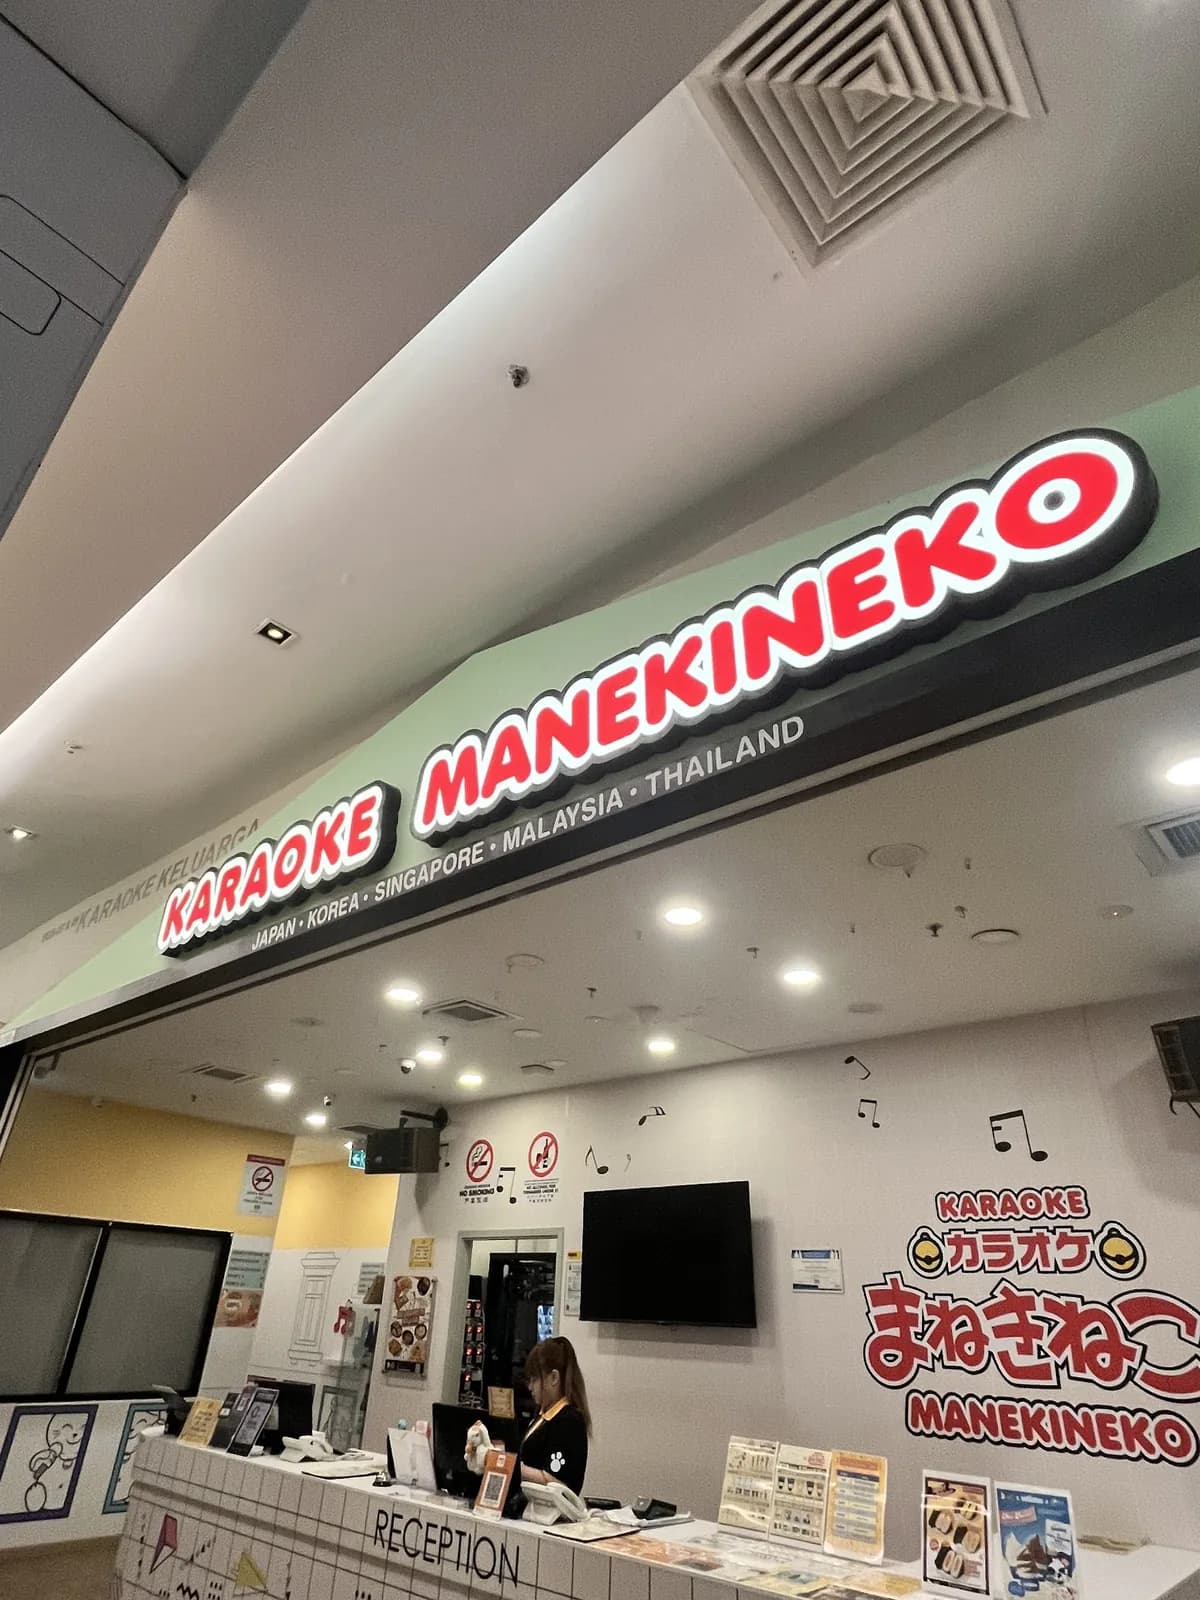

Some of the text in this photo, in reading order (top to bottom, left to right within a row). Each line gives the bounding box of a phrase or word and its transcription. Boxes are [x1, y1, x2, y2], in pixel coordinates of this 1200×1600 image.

[162, 450, 1120, 942] KARAOKE MANEKINEKO
[76, 818, 258, 932] KARAOKE KELUARGA
[252, 715, 805, 951] JAPAN KOREA SINGAPORE MALAYSIA THAILAND
[939, 1190, 1086, 1219] KARAOKE
[946, 1230, 1092, 1270] カラオケ
[867, 1276, 1200, 1395] まねきねこ
[909, 1394, 1193, 1459] MANEKINEKO
[373, 1509, 520, 1589] RECEPTION
